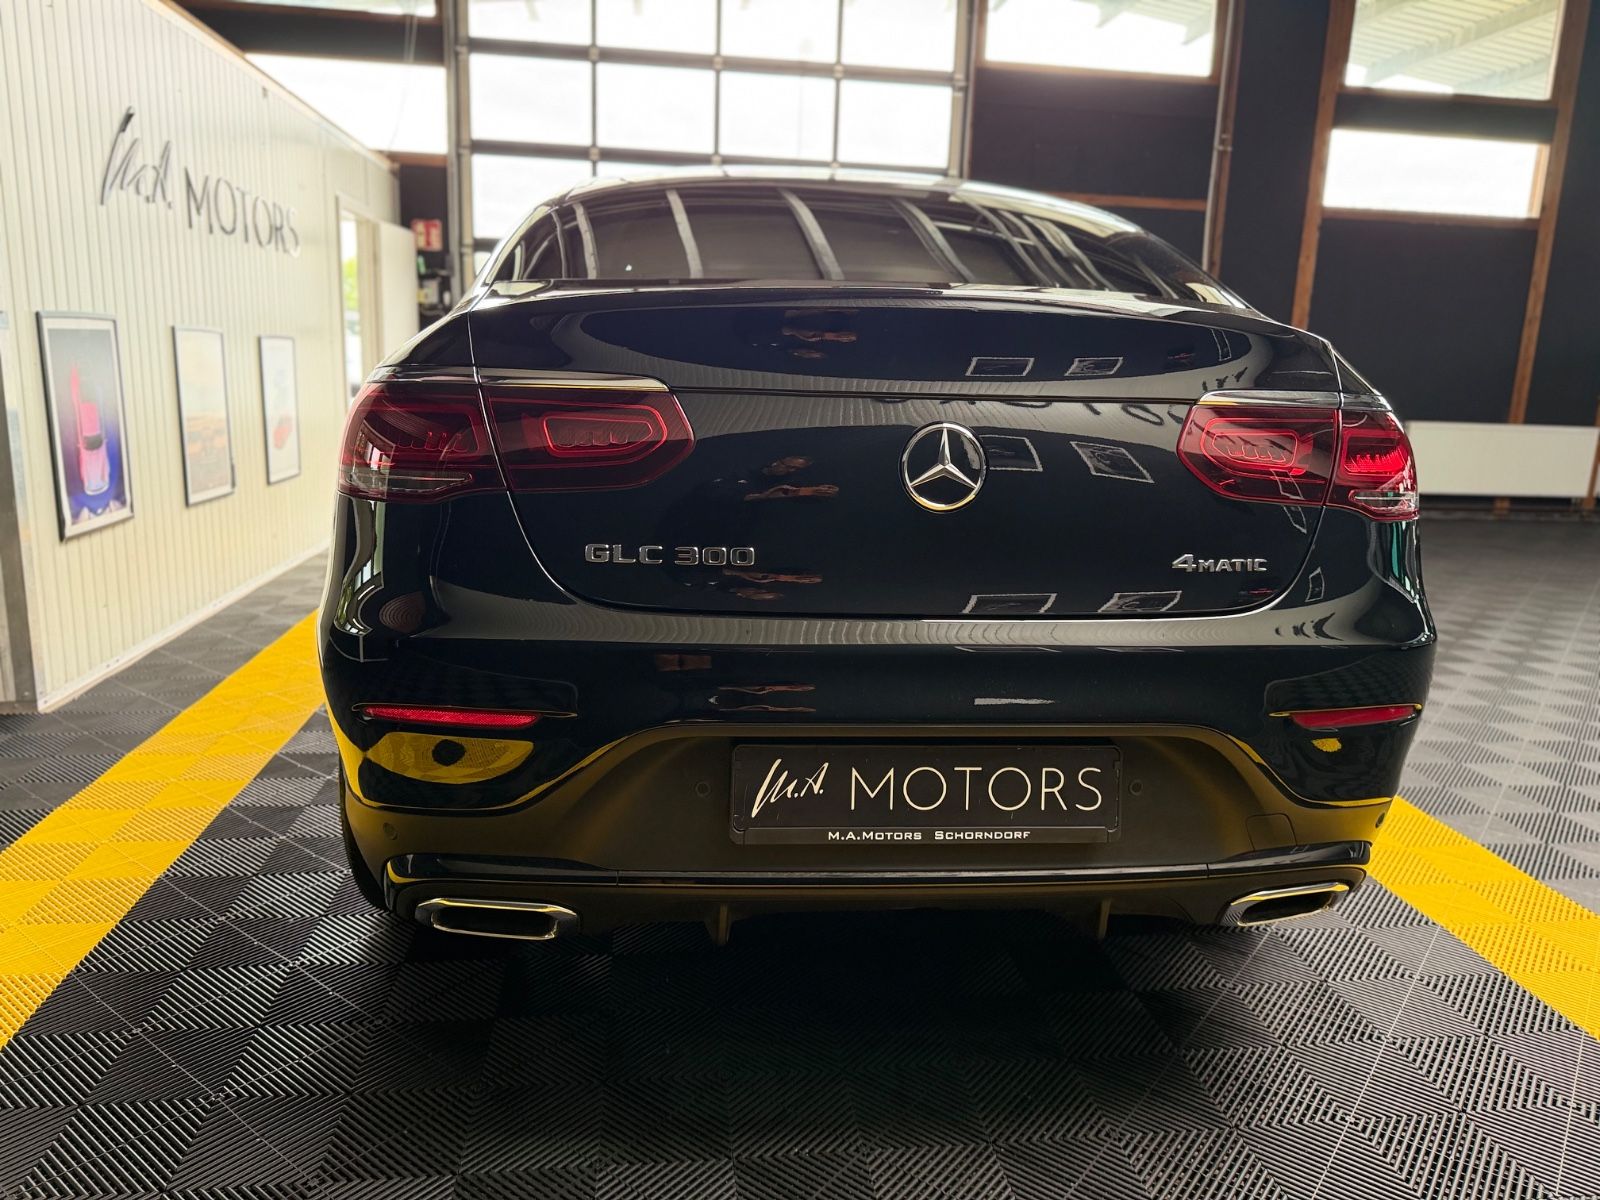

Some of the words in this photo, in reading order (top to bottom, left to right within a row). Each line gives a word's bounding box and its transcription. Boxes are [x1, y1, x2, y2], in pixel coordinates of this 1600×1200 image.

[184, 166, 300, 257] MOTORS
[584, 543, 664, 565] GLC
[674, 546, 756, 567] 300
[1171, 553, 1268, 573] 4MATIC
[751, 758, 829, 819] M.A.
[850, 766, 1102, 811] MOTORS
